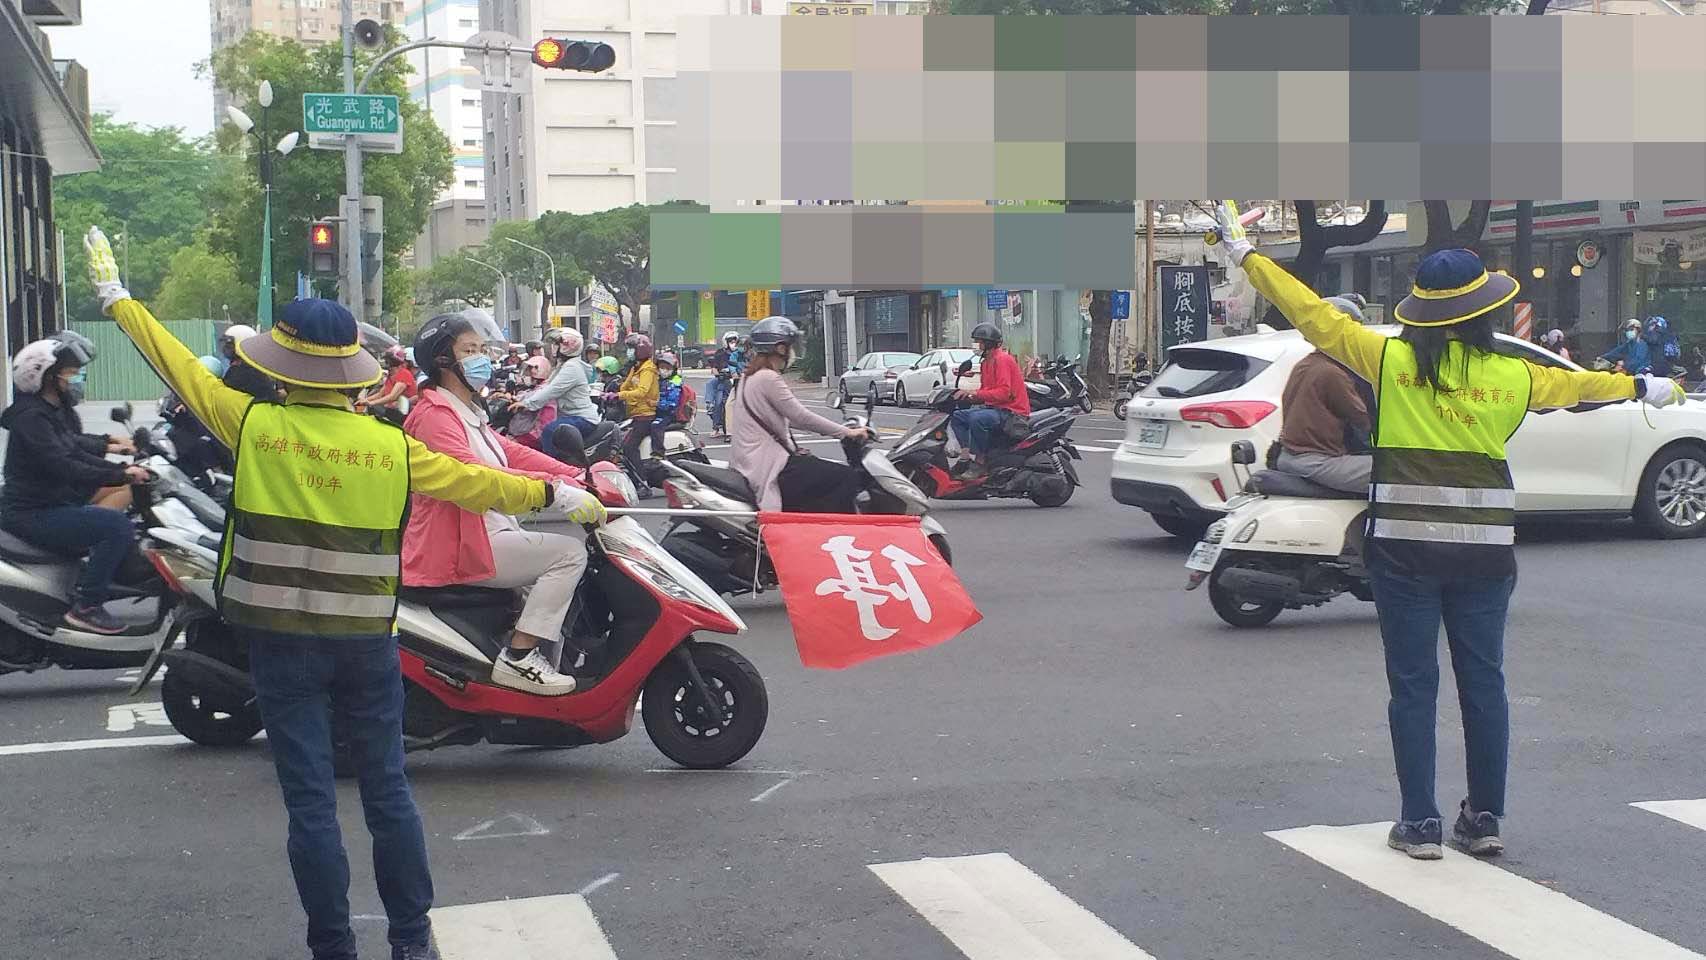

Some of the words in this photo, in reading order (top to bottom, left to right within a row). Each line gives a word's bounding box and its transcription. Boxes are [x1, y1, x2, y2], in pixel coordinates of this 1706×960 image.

[316, 97, 386, 114] 光武路
[317, 115, 365, 132] Guangwu
[255, 433, 394, 472] 高雄市政府教育局
[298, 473, 342, 495] 109年
